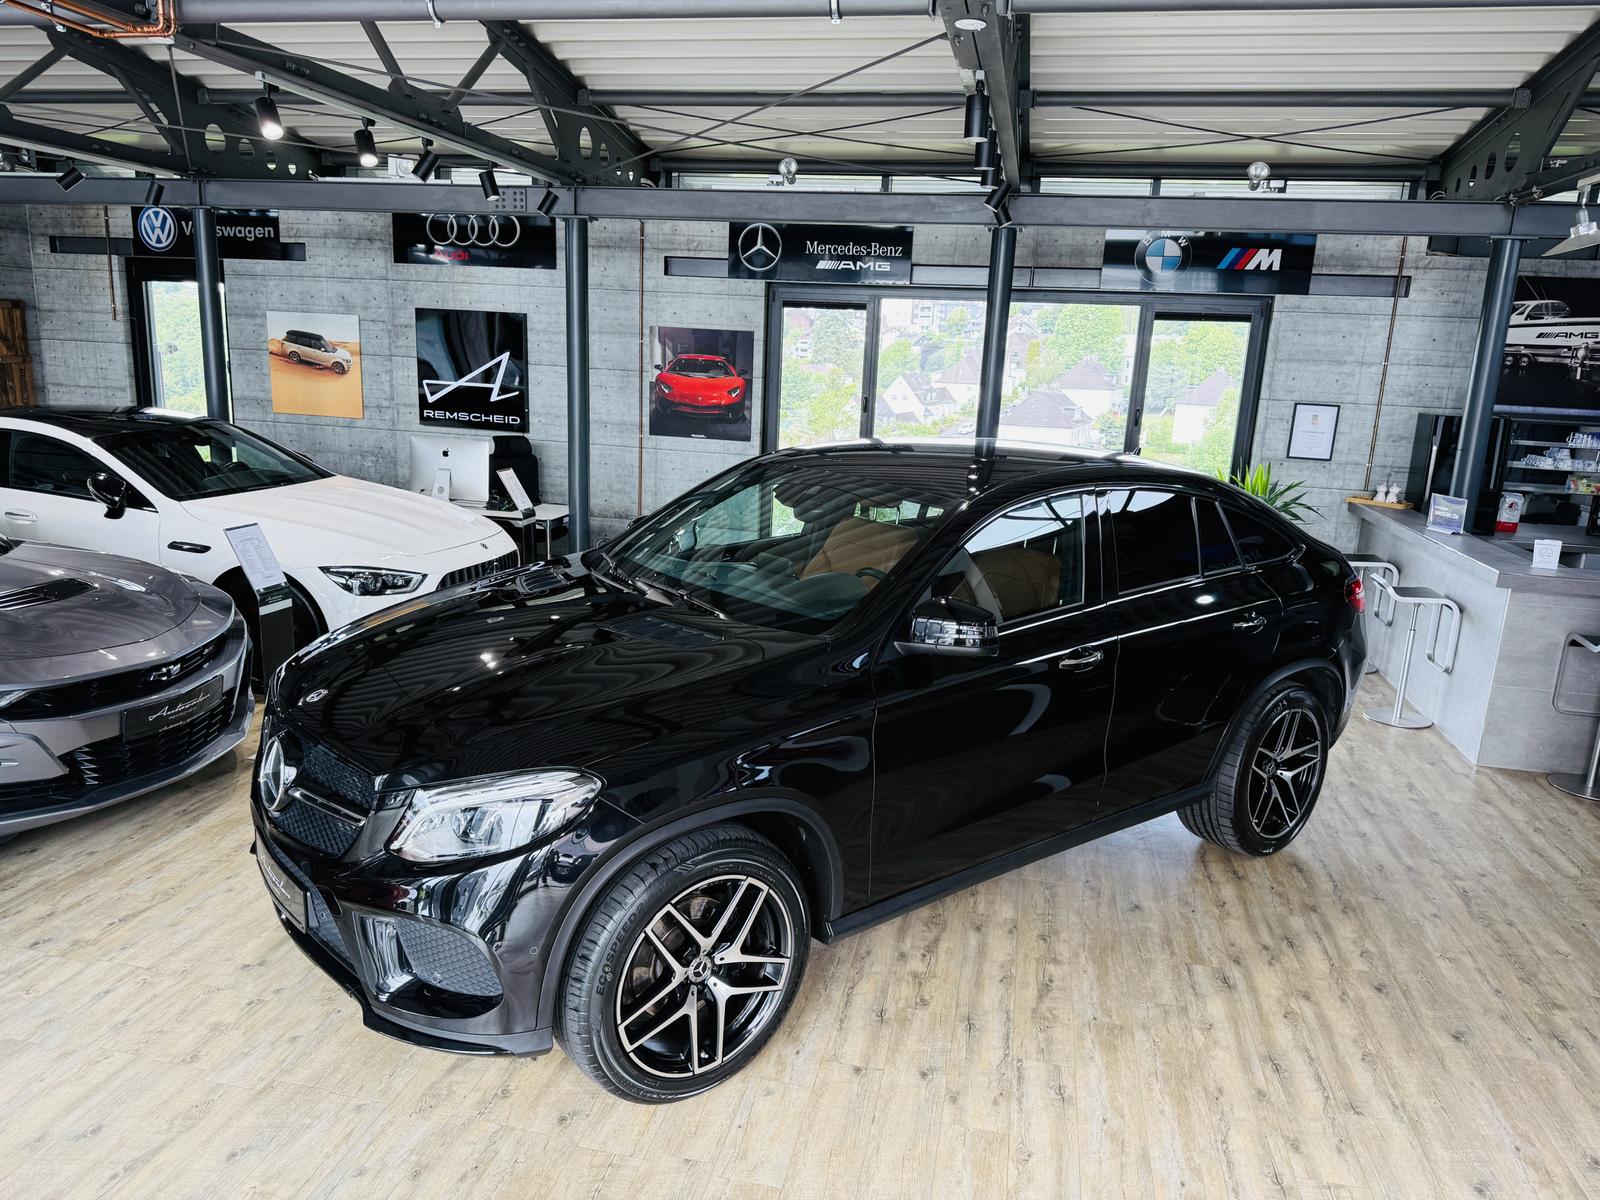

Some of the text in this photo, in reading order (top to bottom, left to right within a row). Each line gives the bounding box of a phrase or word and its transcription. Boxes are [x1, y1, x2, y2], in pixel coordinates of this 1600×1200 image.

[181, 220, 275, 242] Vswagen
[805, 240, 903, 257] Mercedes-Benz
[837, 260, 892, 272] AMG
[1553, 331, 1600, 339] AMG
[423, 409, 521, 425] REMSCHEID
